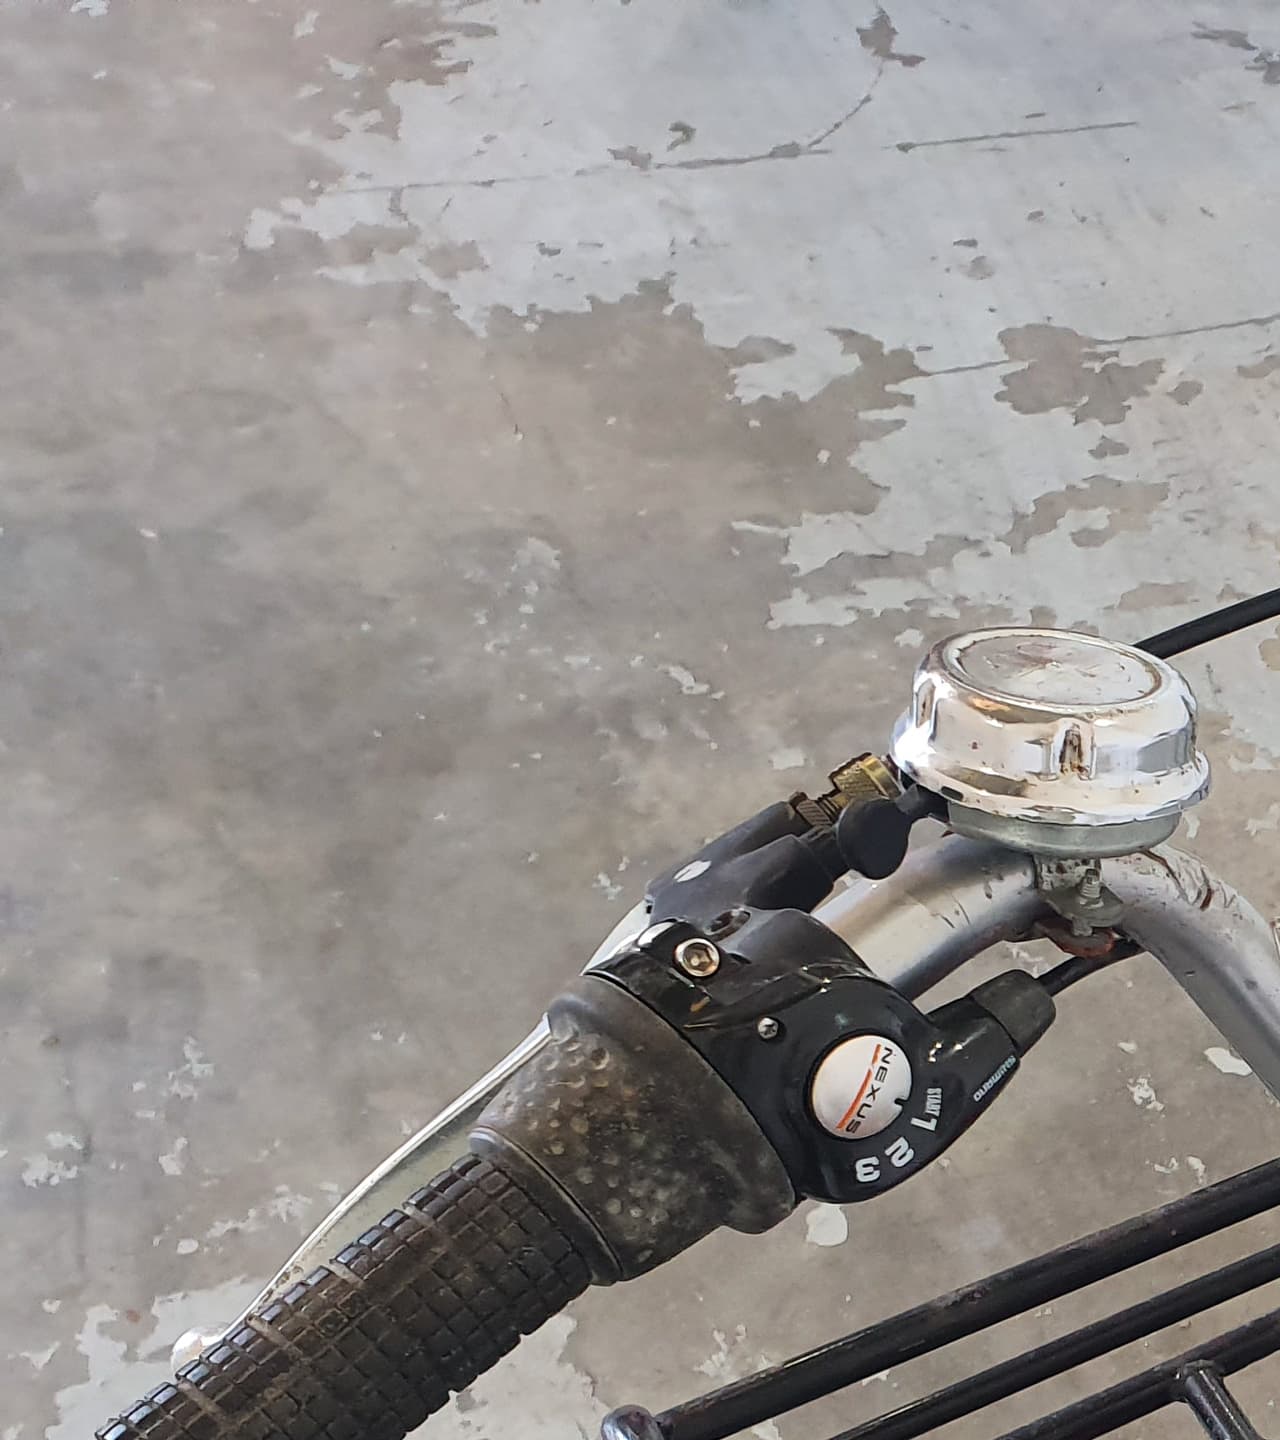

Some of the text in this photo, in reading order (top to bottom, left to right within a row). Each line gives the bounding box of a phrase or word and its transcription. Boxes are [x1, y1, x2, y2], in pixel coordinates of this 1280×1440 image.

[846, 1047, 893, 1134] NEXUS
[925, 1088, 942, 1117] START
[910, 1117, 938, 1131] 1
[885, 1137, 914, 1168] 2
[855, 1156, 880, 1182] 3
